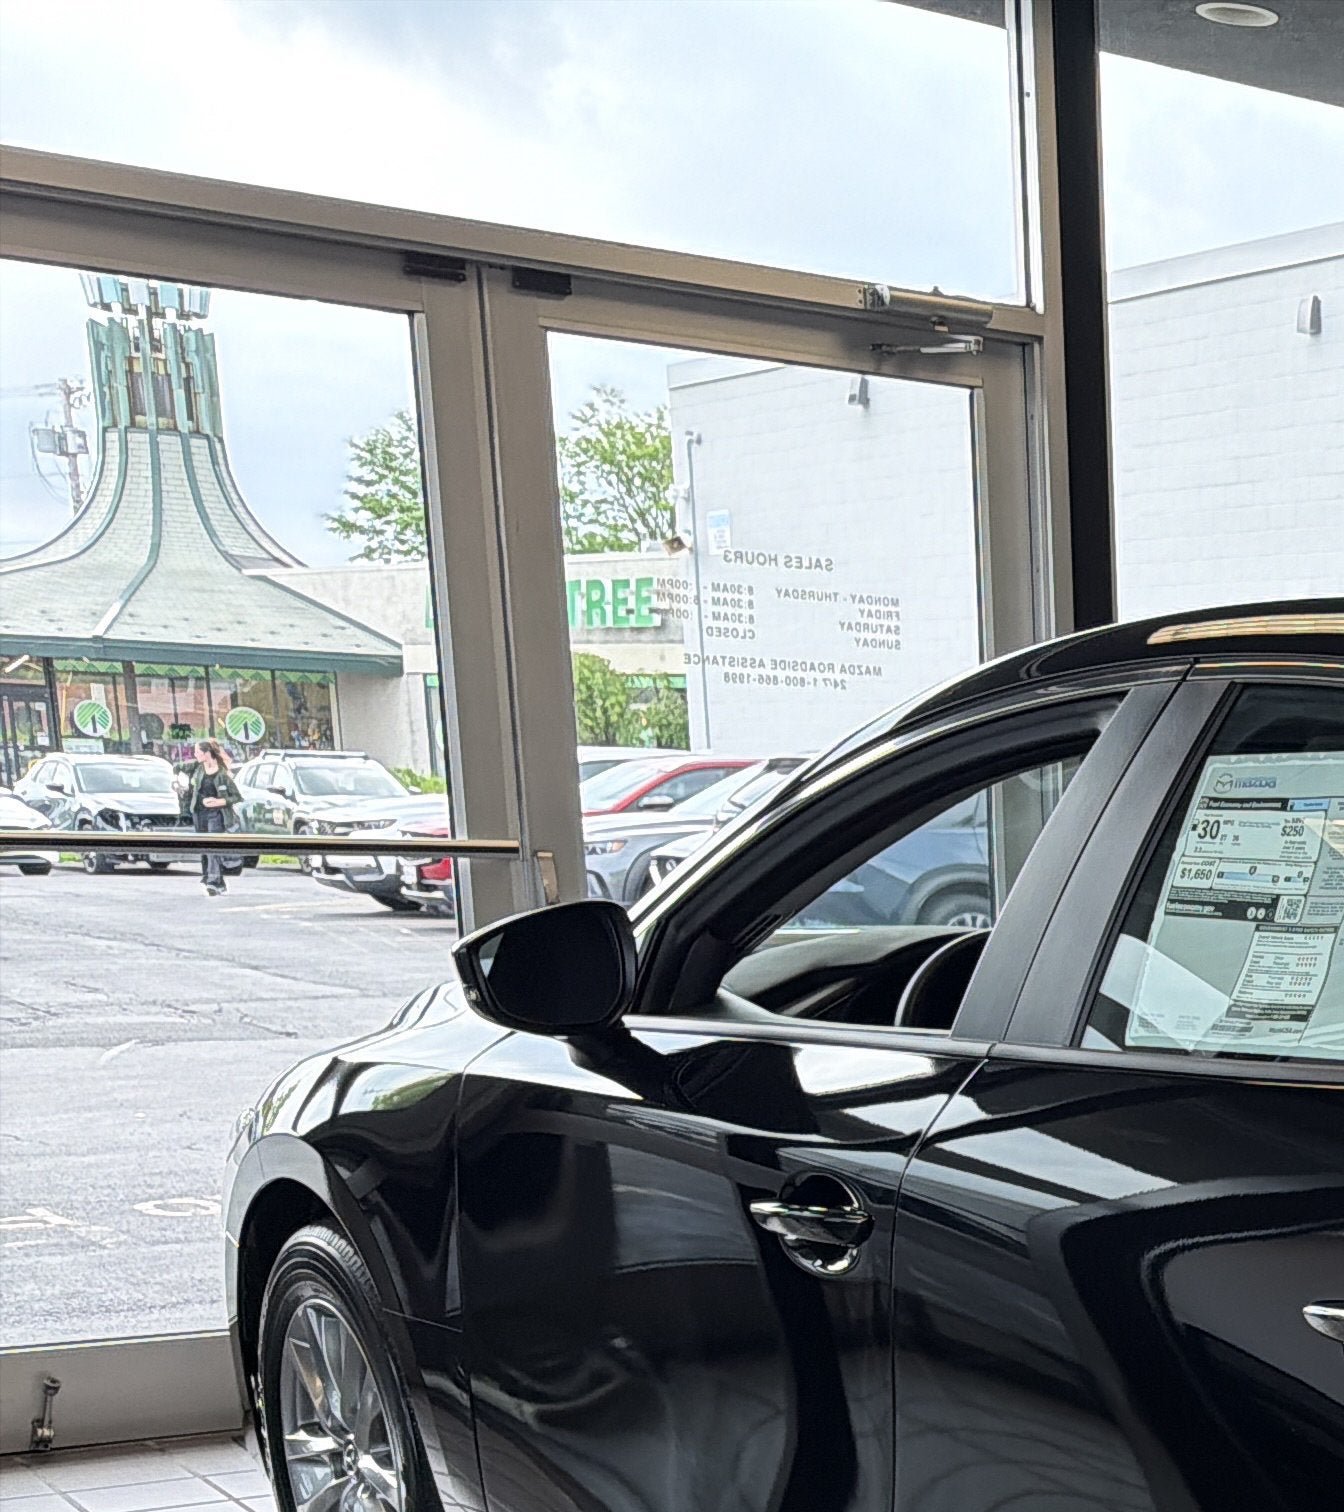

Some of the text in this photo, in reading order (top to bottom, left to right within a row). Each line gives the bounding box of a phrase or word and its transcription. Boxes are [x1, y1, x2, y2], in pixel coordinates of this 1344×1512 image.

[1197, 819, 1220, 840] 30
[1280, 825, 1305, 837] $250
[1179, 867, 1213, 881] $1,650
